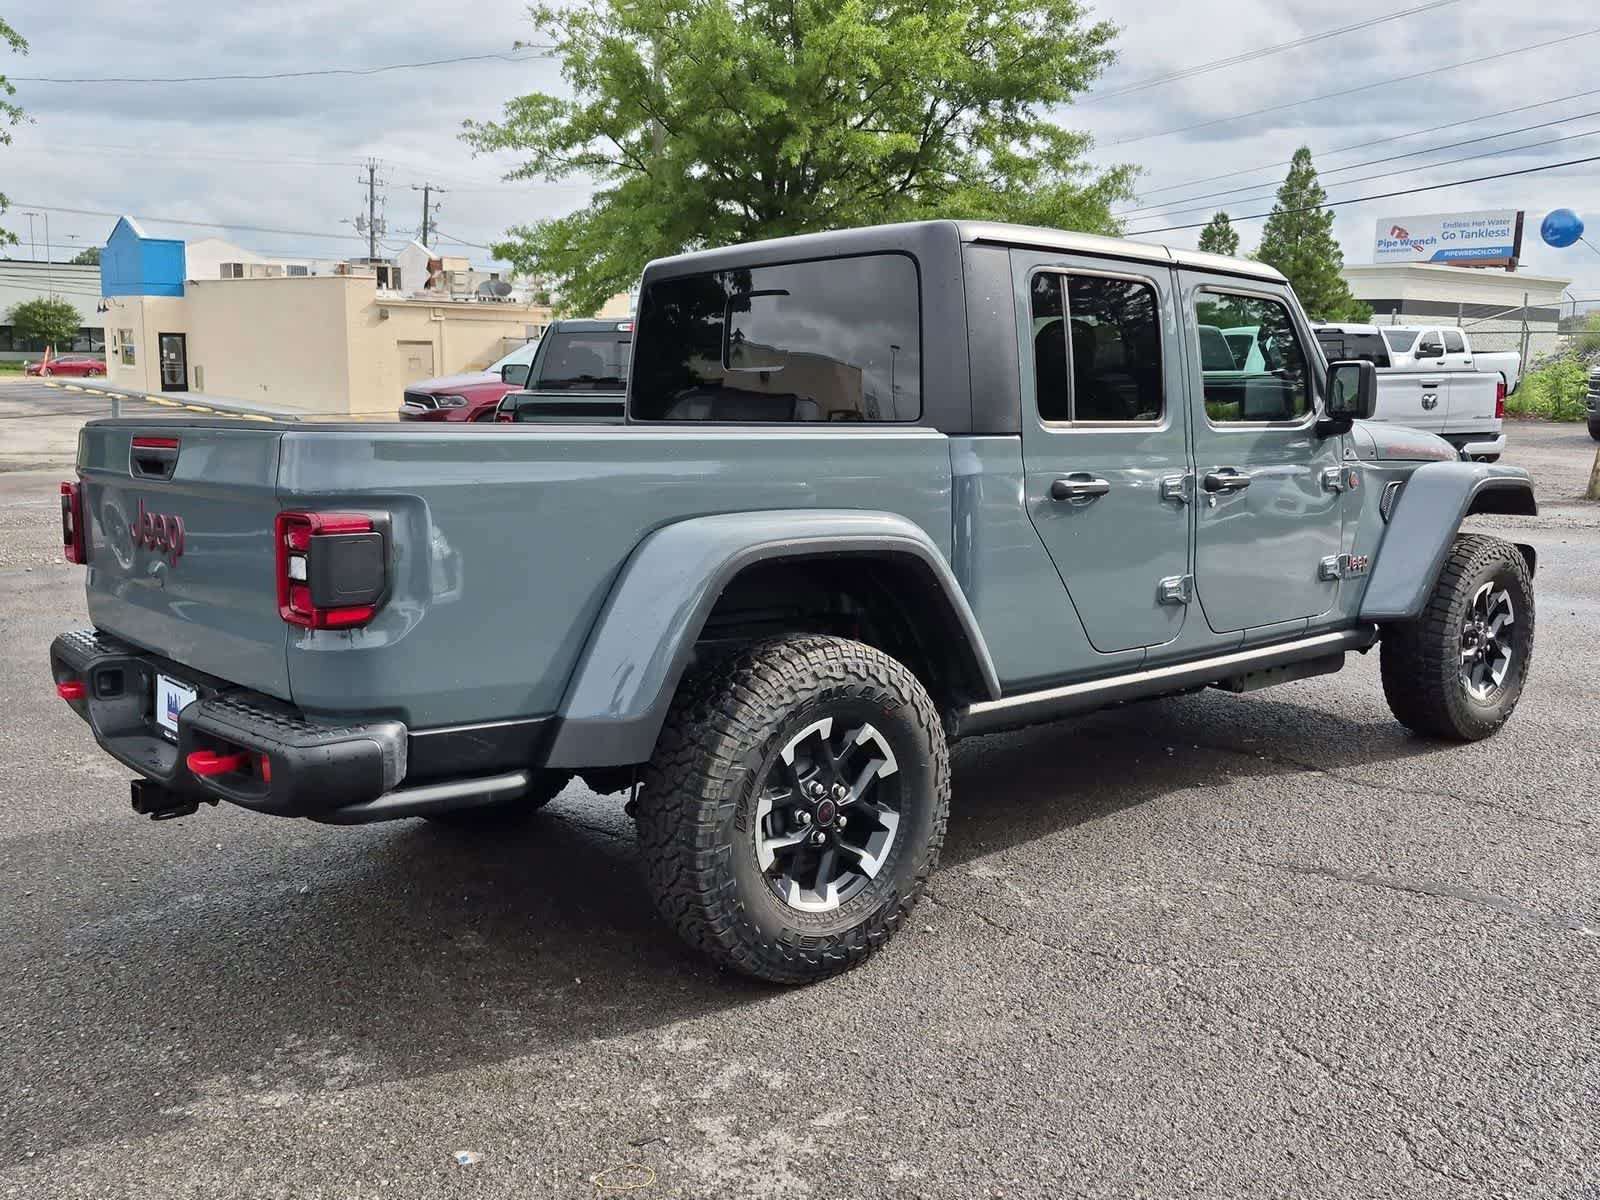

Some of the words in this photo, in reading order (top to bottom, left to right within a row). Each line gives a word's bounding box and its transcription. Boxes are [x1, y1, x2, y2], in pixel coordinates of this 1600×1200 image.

[1443, 221, 1470, 229] Endless
[1488, 218, 1511, 226] Water
[1441, 231, 1456, 240] Go
[1460, 228, 1510, 239] Tankless!
[1377, 238, 1398, 248] Pipe
[1400, 236, 1437, 246] Wrench
[1444, 248, 1503, 257] PIPEWRENCH.COM
[130, 495, 185, 569] Jeep
[1346, 554, 1368, 573] Jeep
